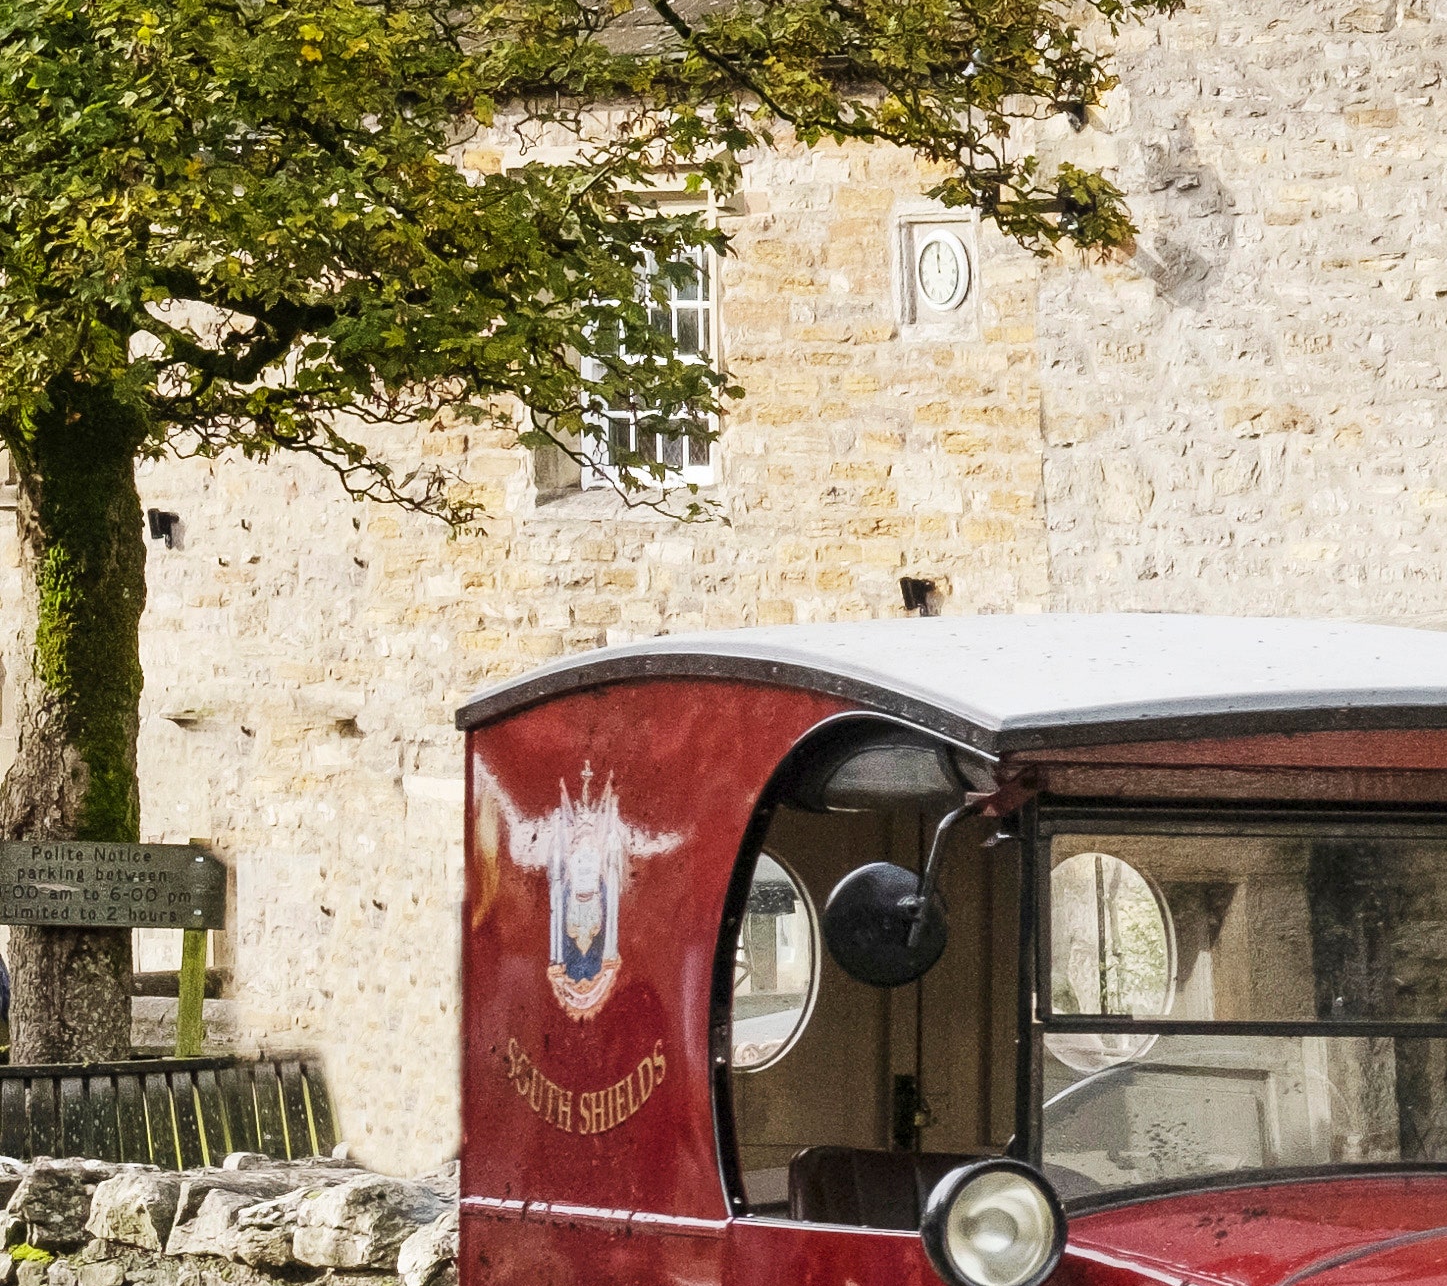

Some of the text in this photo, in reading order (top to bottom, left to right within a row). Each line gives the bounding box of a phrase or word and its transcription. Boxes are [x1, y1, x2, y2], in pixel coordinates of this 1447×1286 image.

[31, 845, 152, 862] Polite Notice
[16, 866, 167, 882] parking between
[3, 884, 39, 899] -00
[50, 888, 73, 901] am
[83, 888, 99, 901] to
[168, 890, 192, 903] pm
[80, 905, 97, 920] to
[107, 906, 118, 921] 2
[128, 906, 177, 923] hours
[507, 1037, 667, 1135] SOUTH SHIELDS
